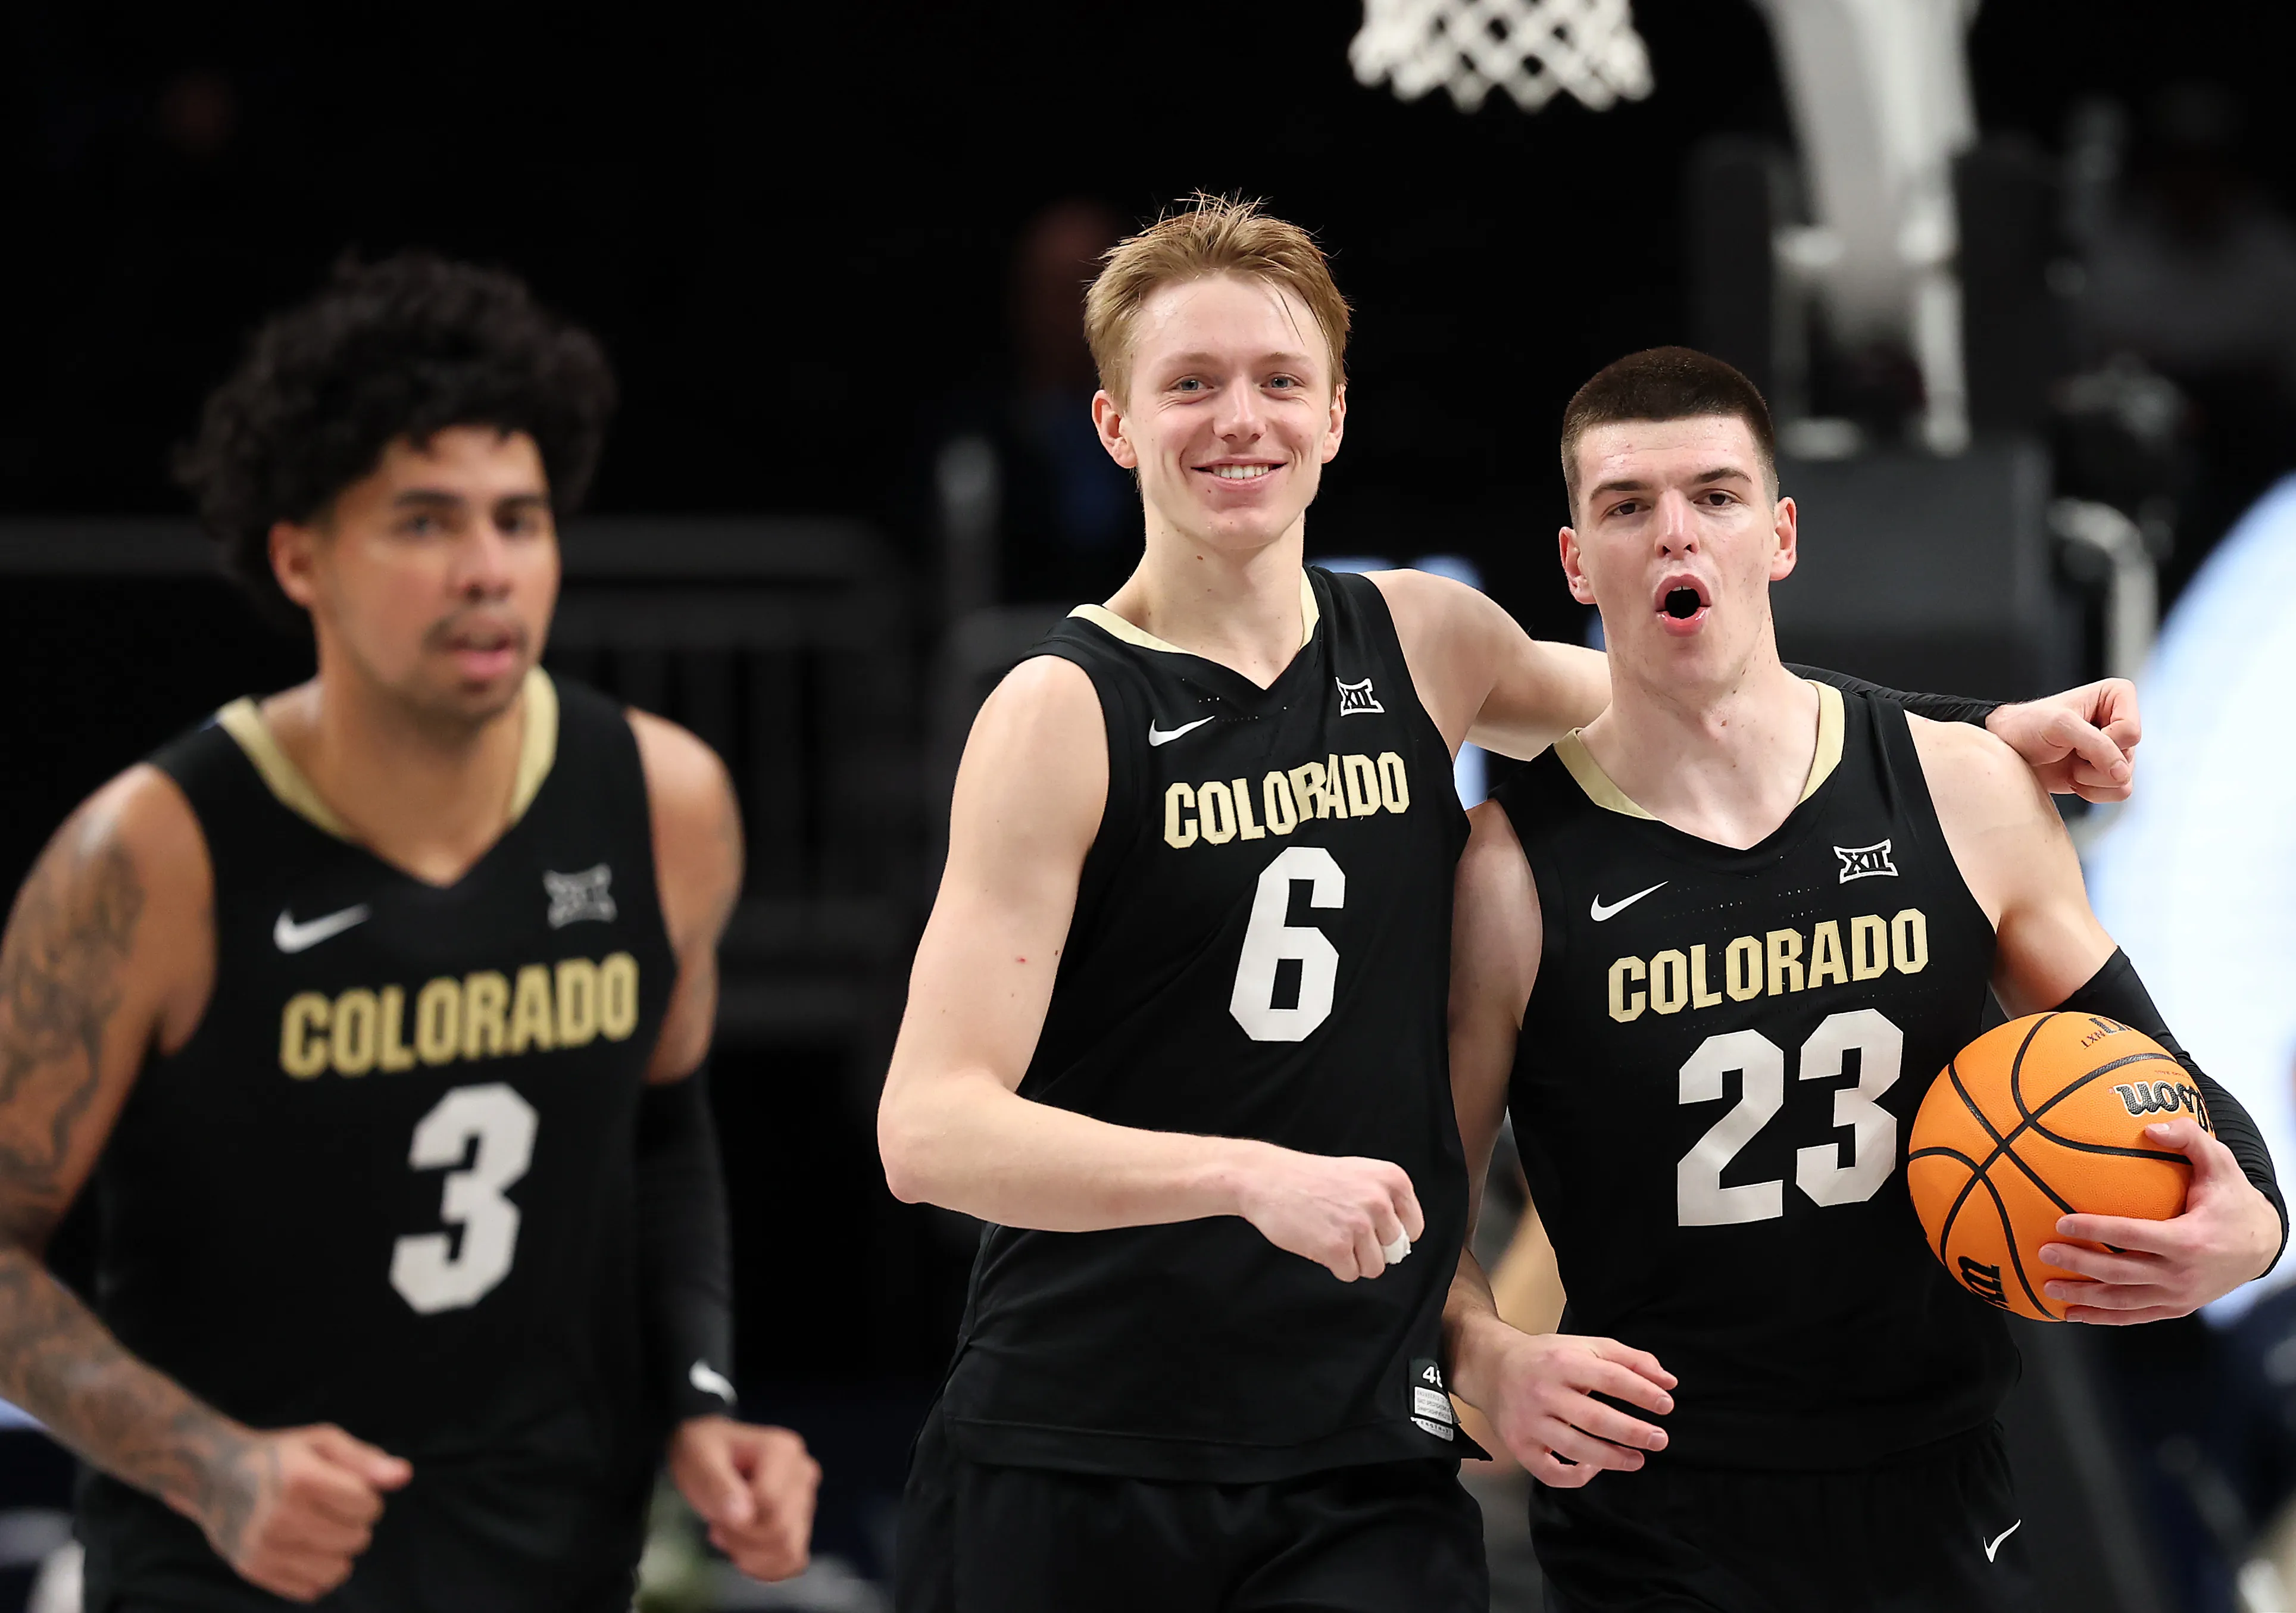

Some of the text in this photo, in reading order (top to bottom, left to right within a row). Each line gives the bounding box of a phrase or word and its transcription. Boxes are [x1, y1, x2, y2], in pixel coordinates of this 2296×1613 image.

[1164, 752, 1410, 849] COLORADO
[1836, 842, 1895, 880] XII
[1229, 847, 1345, 1042] 6
[1608, 908, 1928, 1023] COLORADO
[282, 954, 638, 1076] COLORADO
[1678, 1008, 1903, 1226] 23
[392, 1086, 535, 1311] 3
